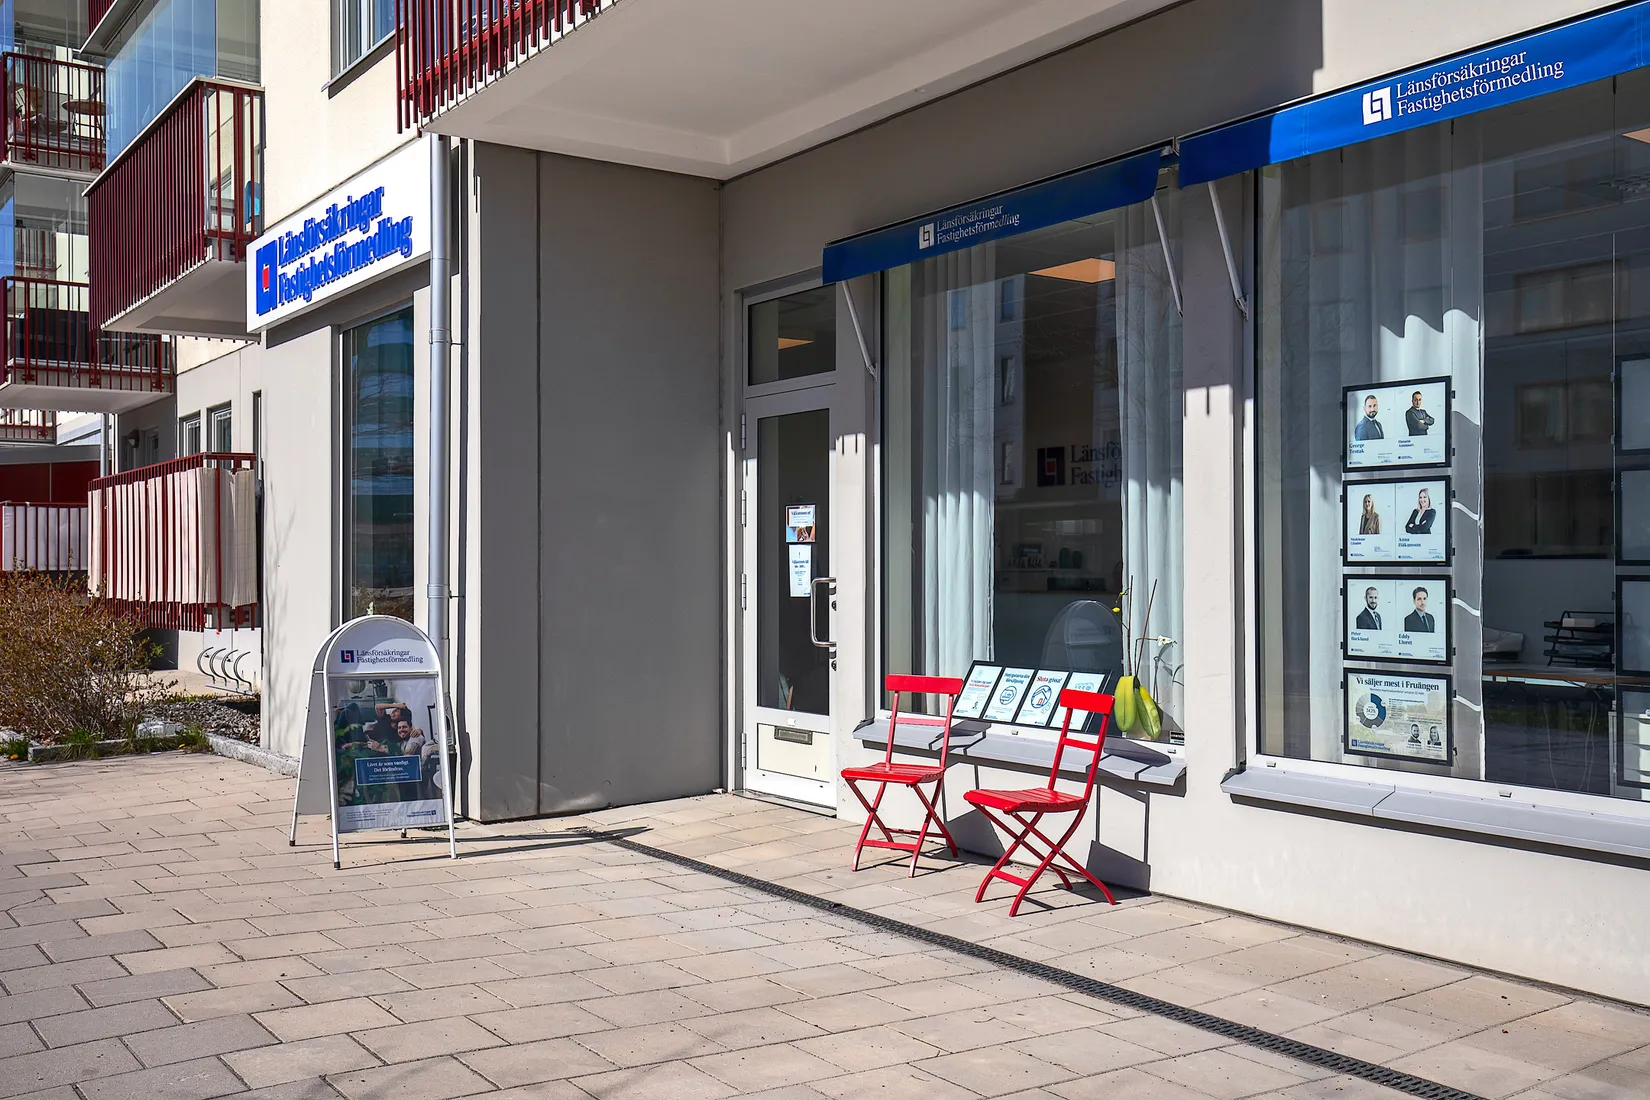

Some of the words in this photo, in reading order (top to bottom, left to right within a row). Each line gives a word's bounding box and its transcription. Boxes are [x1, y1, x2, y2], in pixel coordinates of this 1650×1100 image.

[1396, 51, 1527, 99] Länsförsäkringar
[1397, 60, 1565, 117] Fastighetsförmedling
[278, 186, 385, 269] Länsförsäkringar
[937, 204, 1004, 232] Länsförsäkringar
[937, 213, 1020, 245] Fastighetsförmedling
[278, 216, 413, 307] Fastighetsförmedling
[356, 649, 410, 658] Länsförsäkringar
[356, 656, 424, 665] Fastighetsförmedling
[1036, 675, 1049, 683] Sluta
[1356, 677, 1364, 685] Vi
[1364, 678, 1383, 688] säljer
[1384, 680, 1401, 688] mest
[1405, 681, 1440, 692] Fruängen
